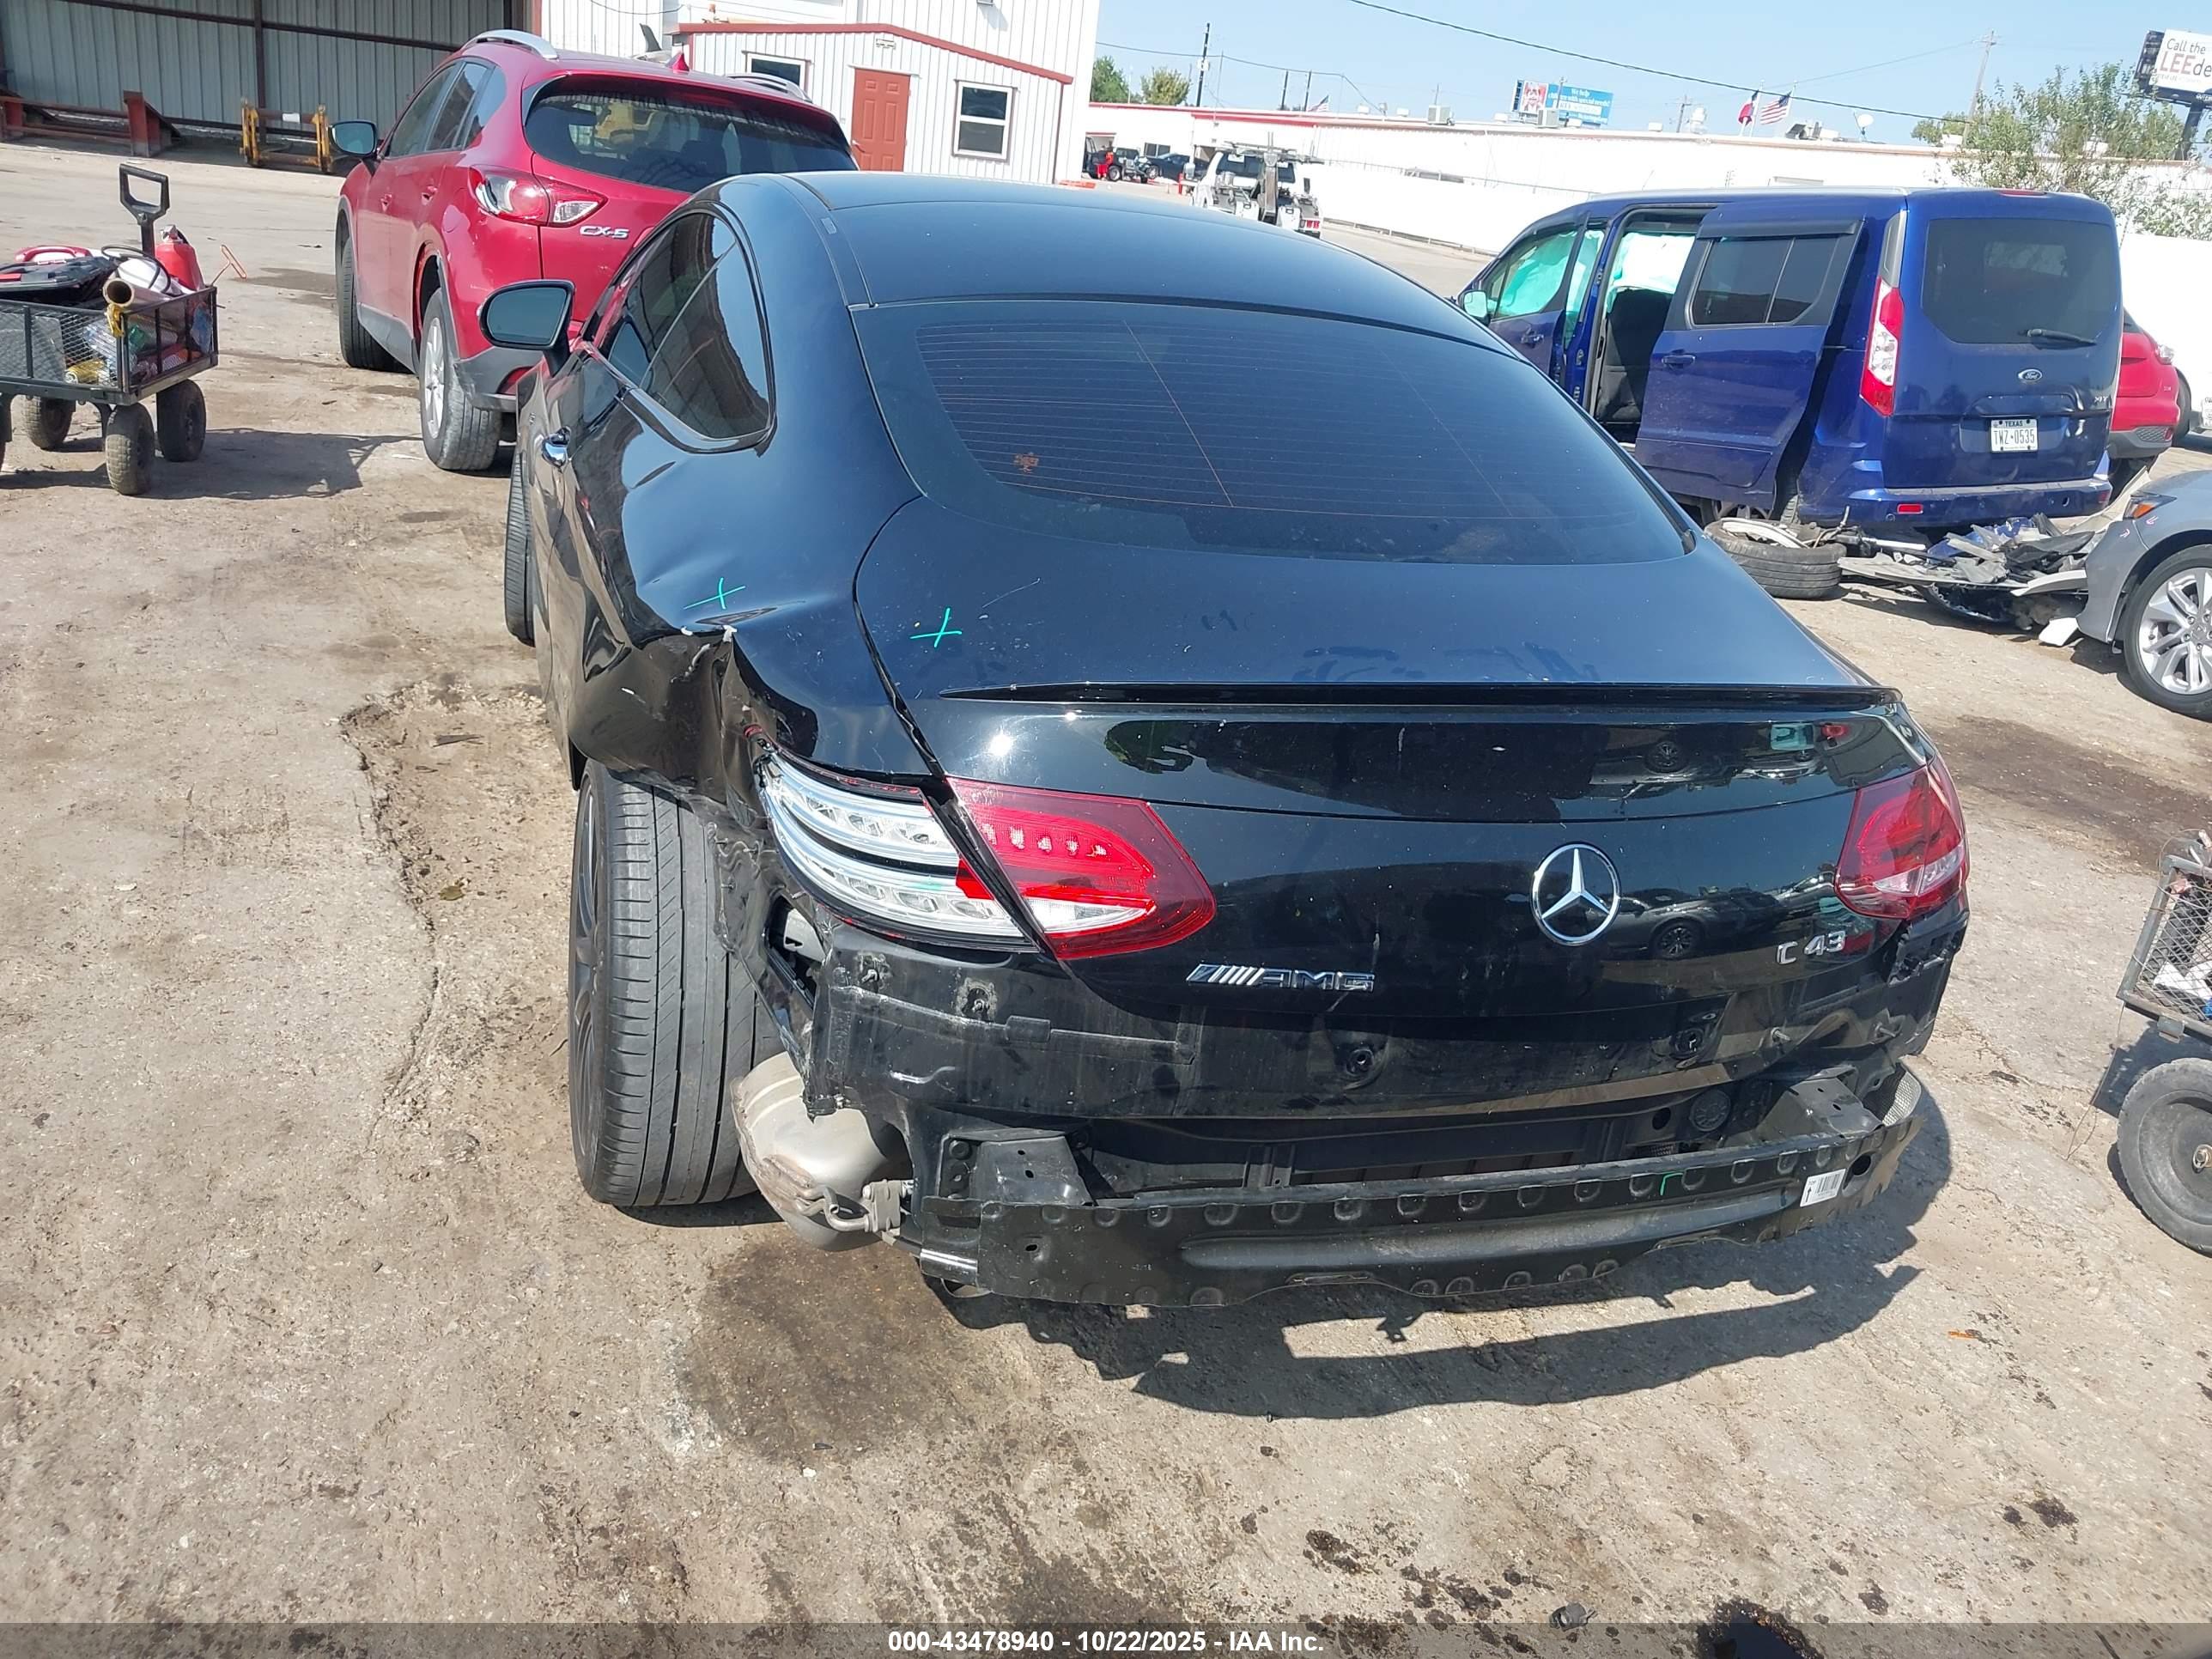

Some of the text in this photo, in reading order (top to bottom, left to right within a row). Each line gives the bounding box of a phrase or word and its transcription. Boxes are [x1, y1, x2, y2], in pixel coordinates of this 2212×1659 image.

[2166, 38, 2206, 54] Call the
[1579, 88, 1590, 99] help
[580, 225, 629, 240] CX-5
[1776, 930, 1846, 964] C 43
